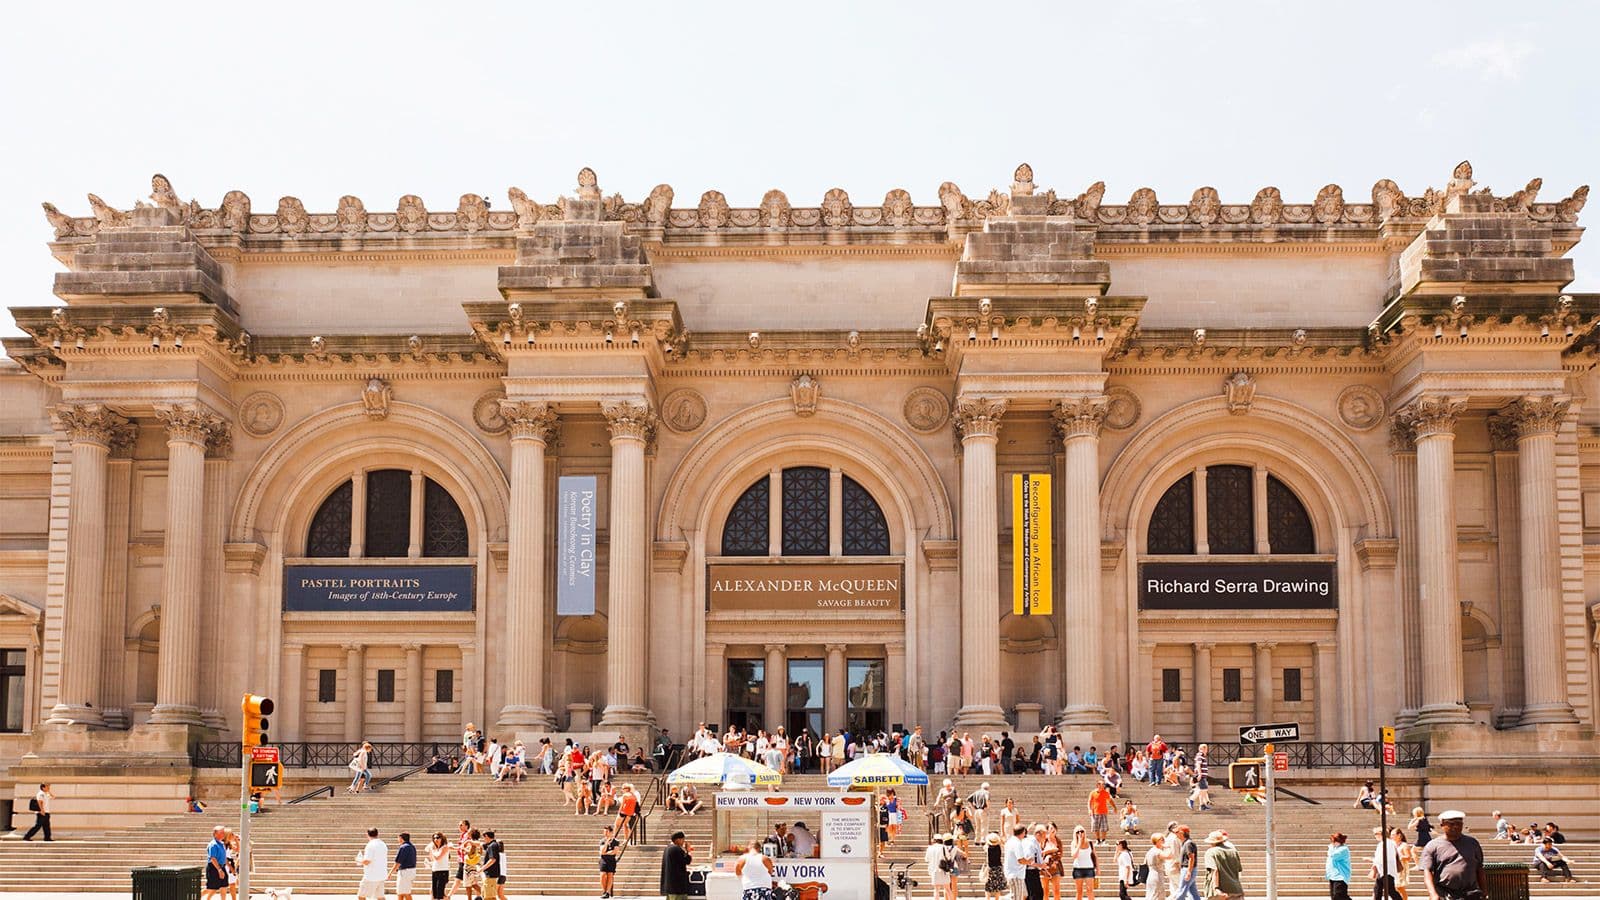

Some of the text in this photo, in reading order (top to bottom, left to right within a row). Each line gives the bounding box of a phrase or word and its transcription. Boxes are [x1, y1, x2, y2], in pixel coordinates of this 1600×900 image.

[569, 491, 578, 515] Korean
[577, 491, 593, 577] Poetry in Clay
[1031, 480, 1041, 608] Reconfiguring an African Icon
[301, 579, 420, 588] PASTEL PORTRAITS
[712, 579, 898, 594] ALEXANDER McQUEEN
[1147, 579, 1329, 596] Richard Serra Drawing
[328, 591, 458, 602] Images of 18th-Century Europe
[817, 599, 891, 607] SAVAGE BEAUTY
[1247, 729, 1292, 739] ONE WAY
[854, 775, 900, 783] SABRETT
[717, 797, 759, 805] NEW YORK
[794, 797, 836, 805] NEW YORK
[771, 865, 825, 877] EW YORK
